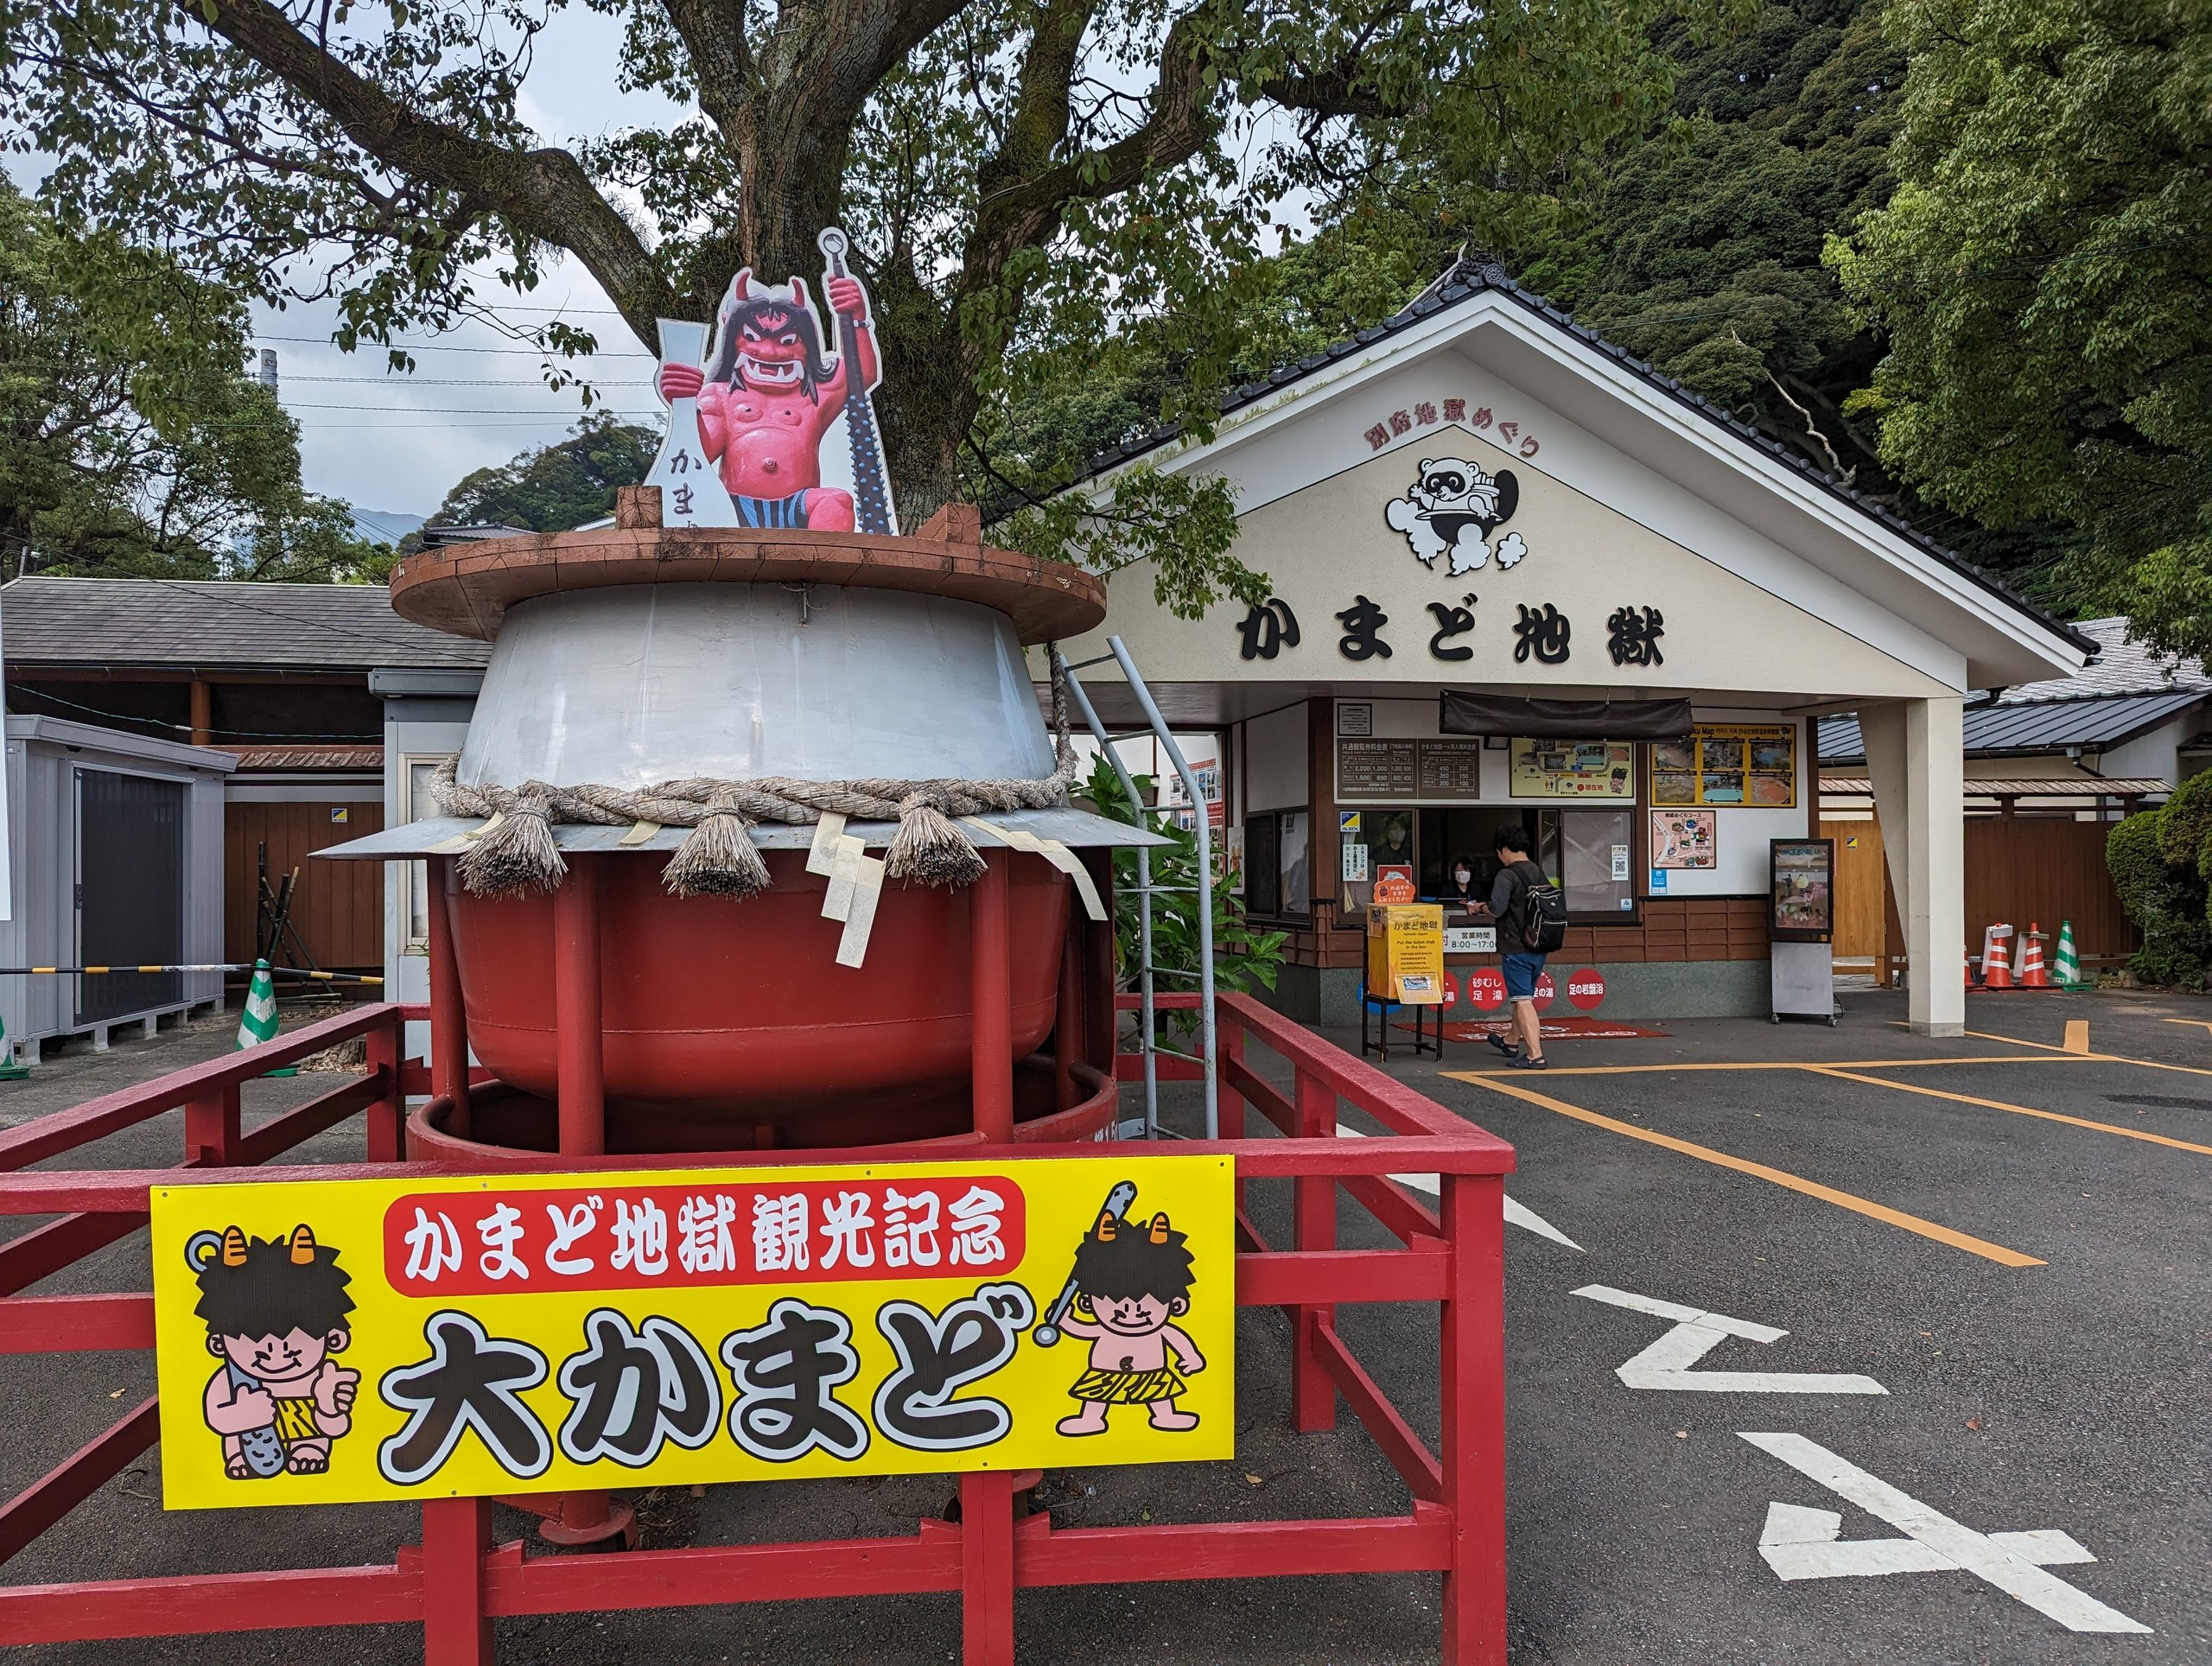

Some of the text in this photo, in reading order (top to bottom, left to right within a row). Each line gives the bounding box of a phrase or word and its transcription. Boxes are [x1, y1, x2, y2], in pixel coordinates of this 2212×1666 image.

[1361, 397, 1541, 459] 別府地獄めぐり
[671, 448, 702, 528] かま
[1236, 592, 1666, 667] かまど地獄
[1701, 727, 1715, 735] Map
[1394, 920, 1438, 931] かまど地獄
[1472, 977, 1502, 988] 砂むし
[1568, 983, 1604, 995] 足の岩盤浴
[404, 1188, 1007, 1281] かまど地獄観光記念
[377, 1281, 1035, 1486] 大かまど
